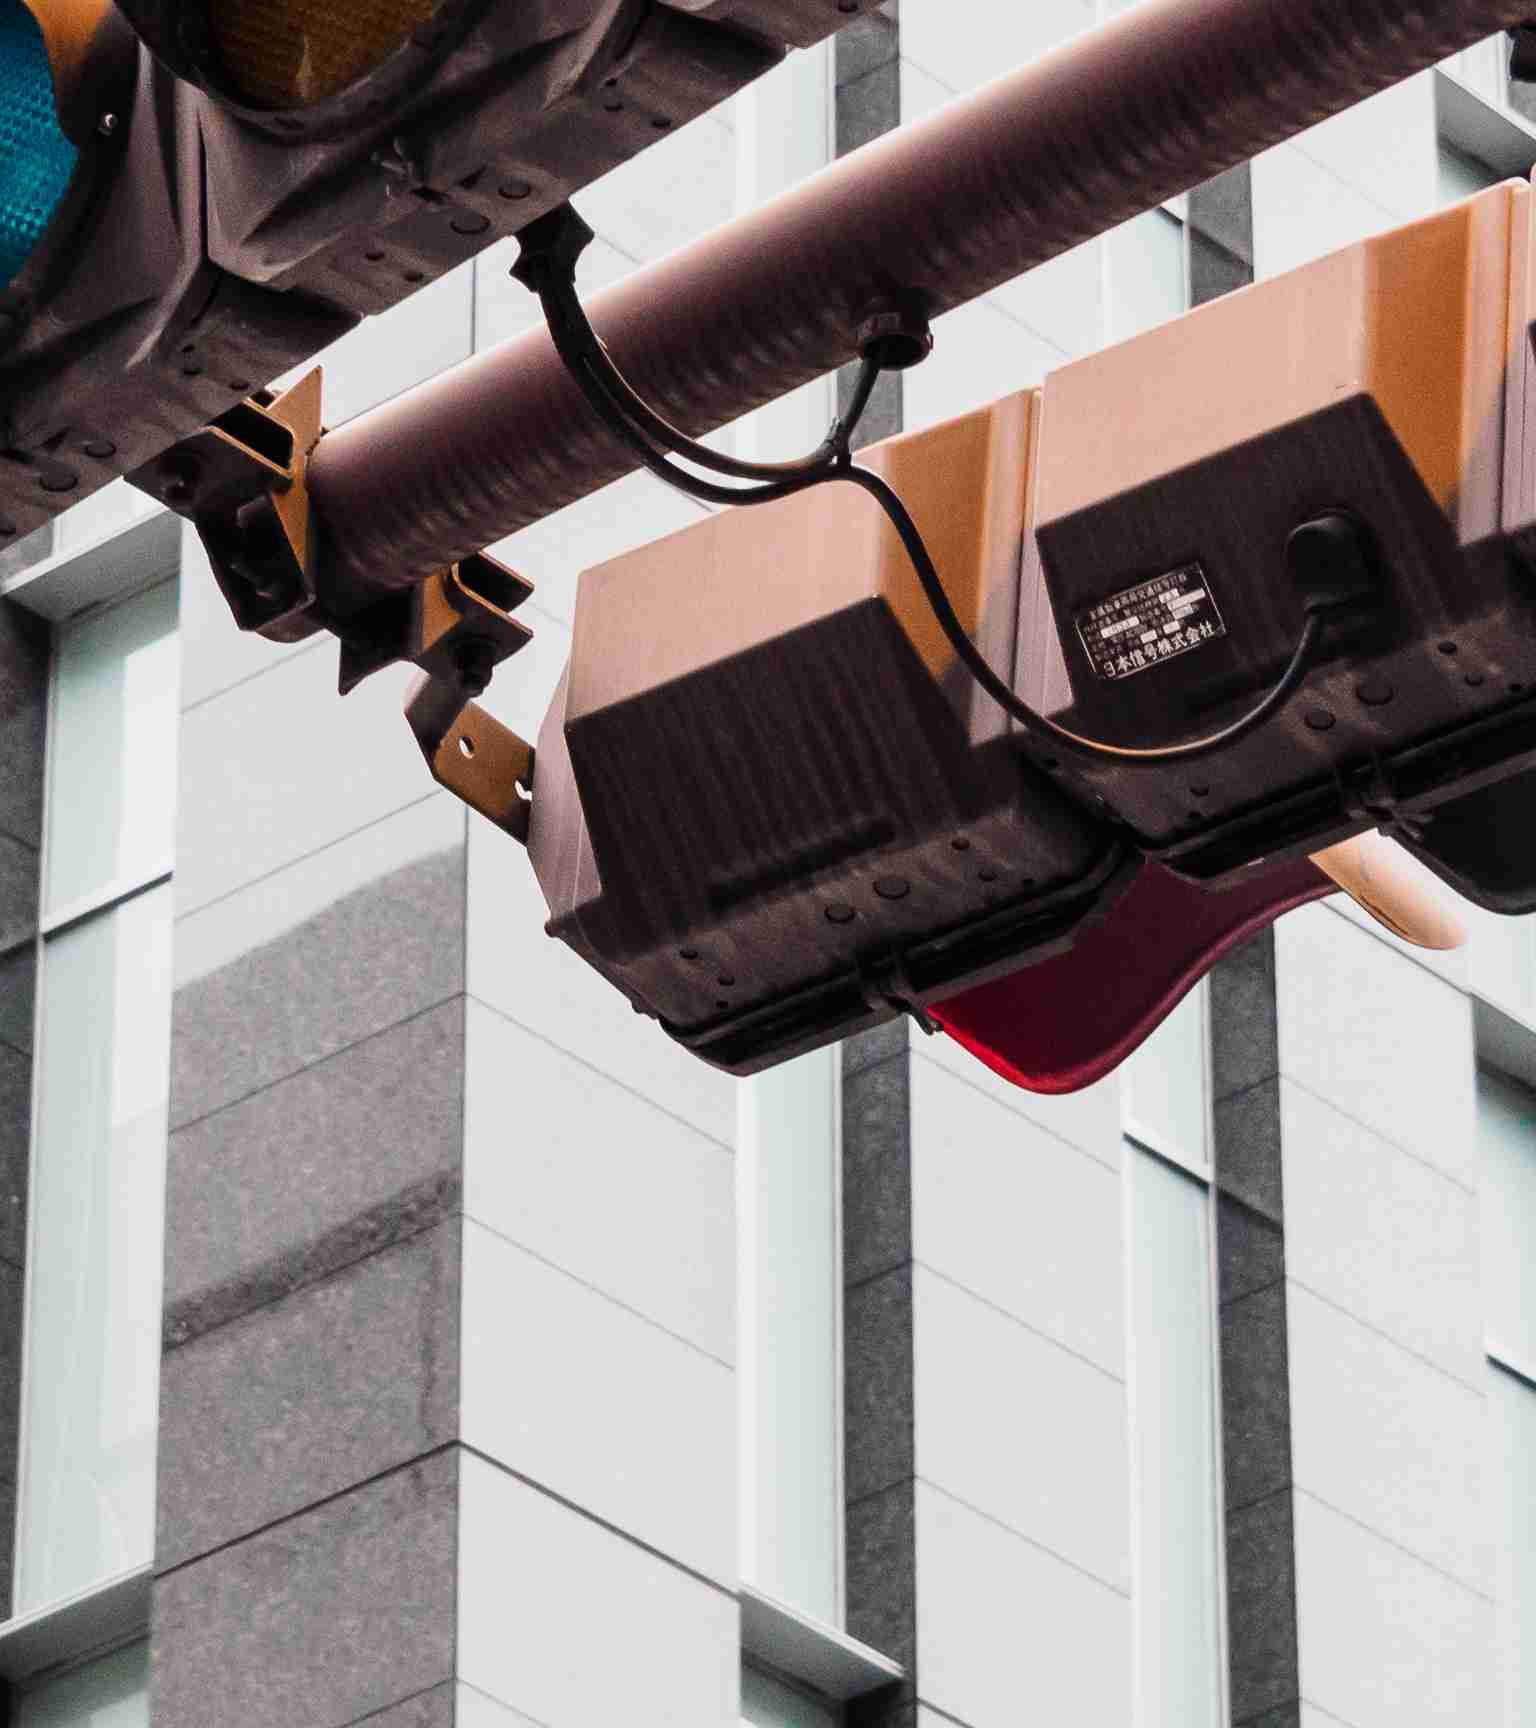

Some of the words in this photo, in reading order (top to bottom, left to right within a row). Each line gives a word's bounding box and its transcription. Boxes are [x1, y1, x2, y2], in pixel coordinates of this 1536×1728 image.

[1104, 620, 1214, 677] 日本信号株式会社
